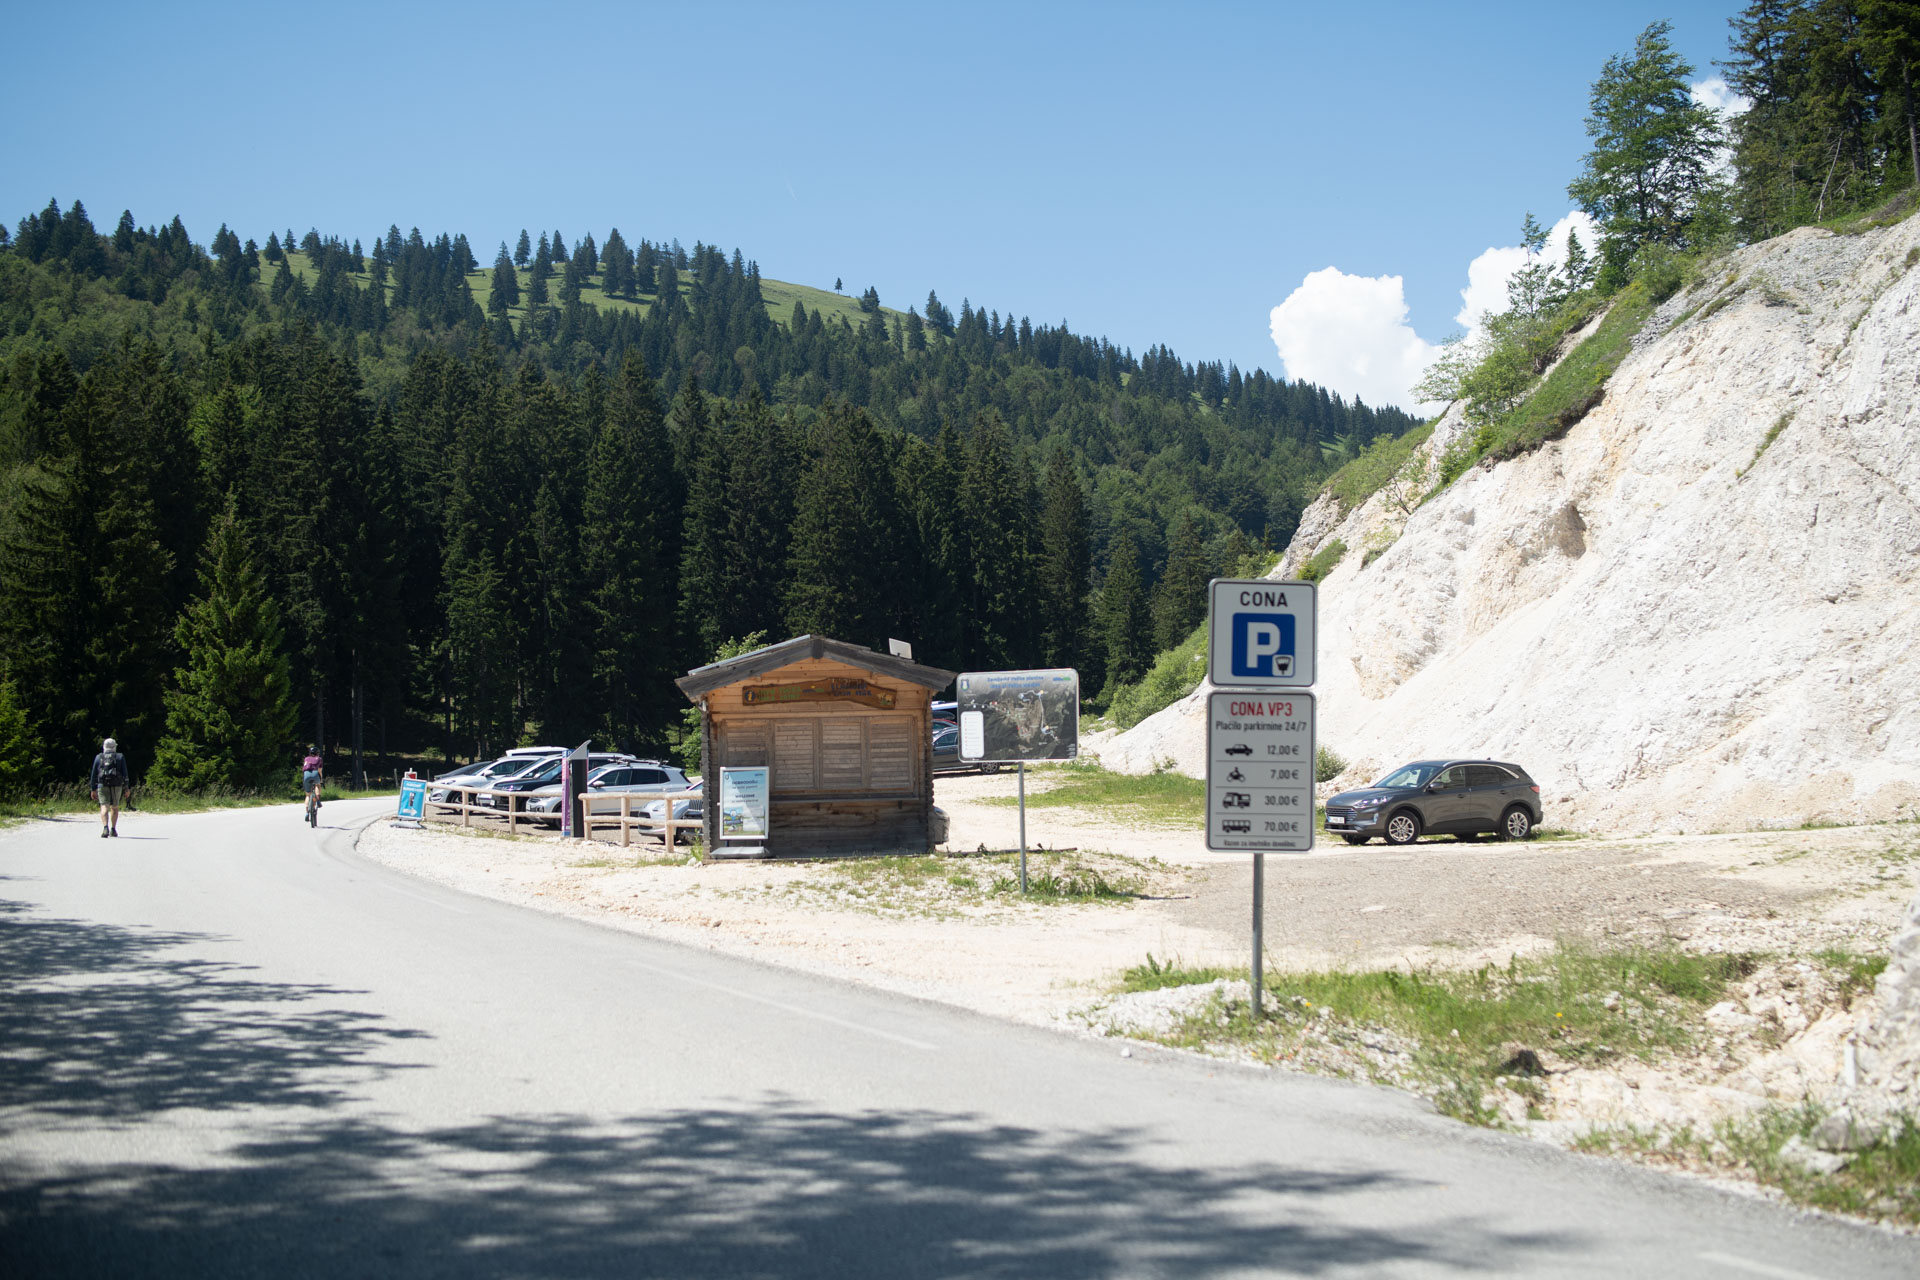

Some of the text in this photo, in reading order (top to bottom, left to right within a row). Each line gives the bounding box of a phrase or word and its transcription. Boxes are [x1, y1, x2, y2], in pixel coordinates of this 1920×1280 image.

[1240, 591, 1288, 607] CONA
[1246, 621, 1281, 668] P
[1230, 701, 1293, 717] CONA VP3
[1216, 720, 1307, 732] Plačilo parkirnine 24/7
